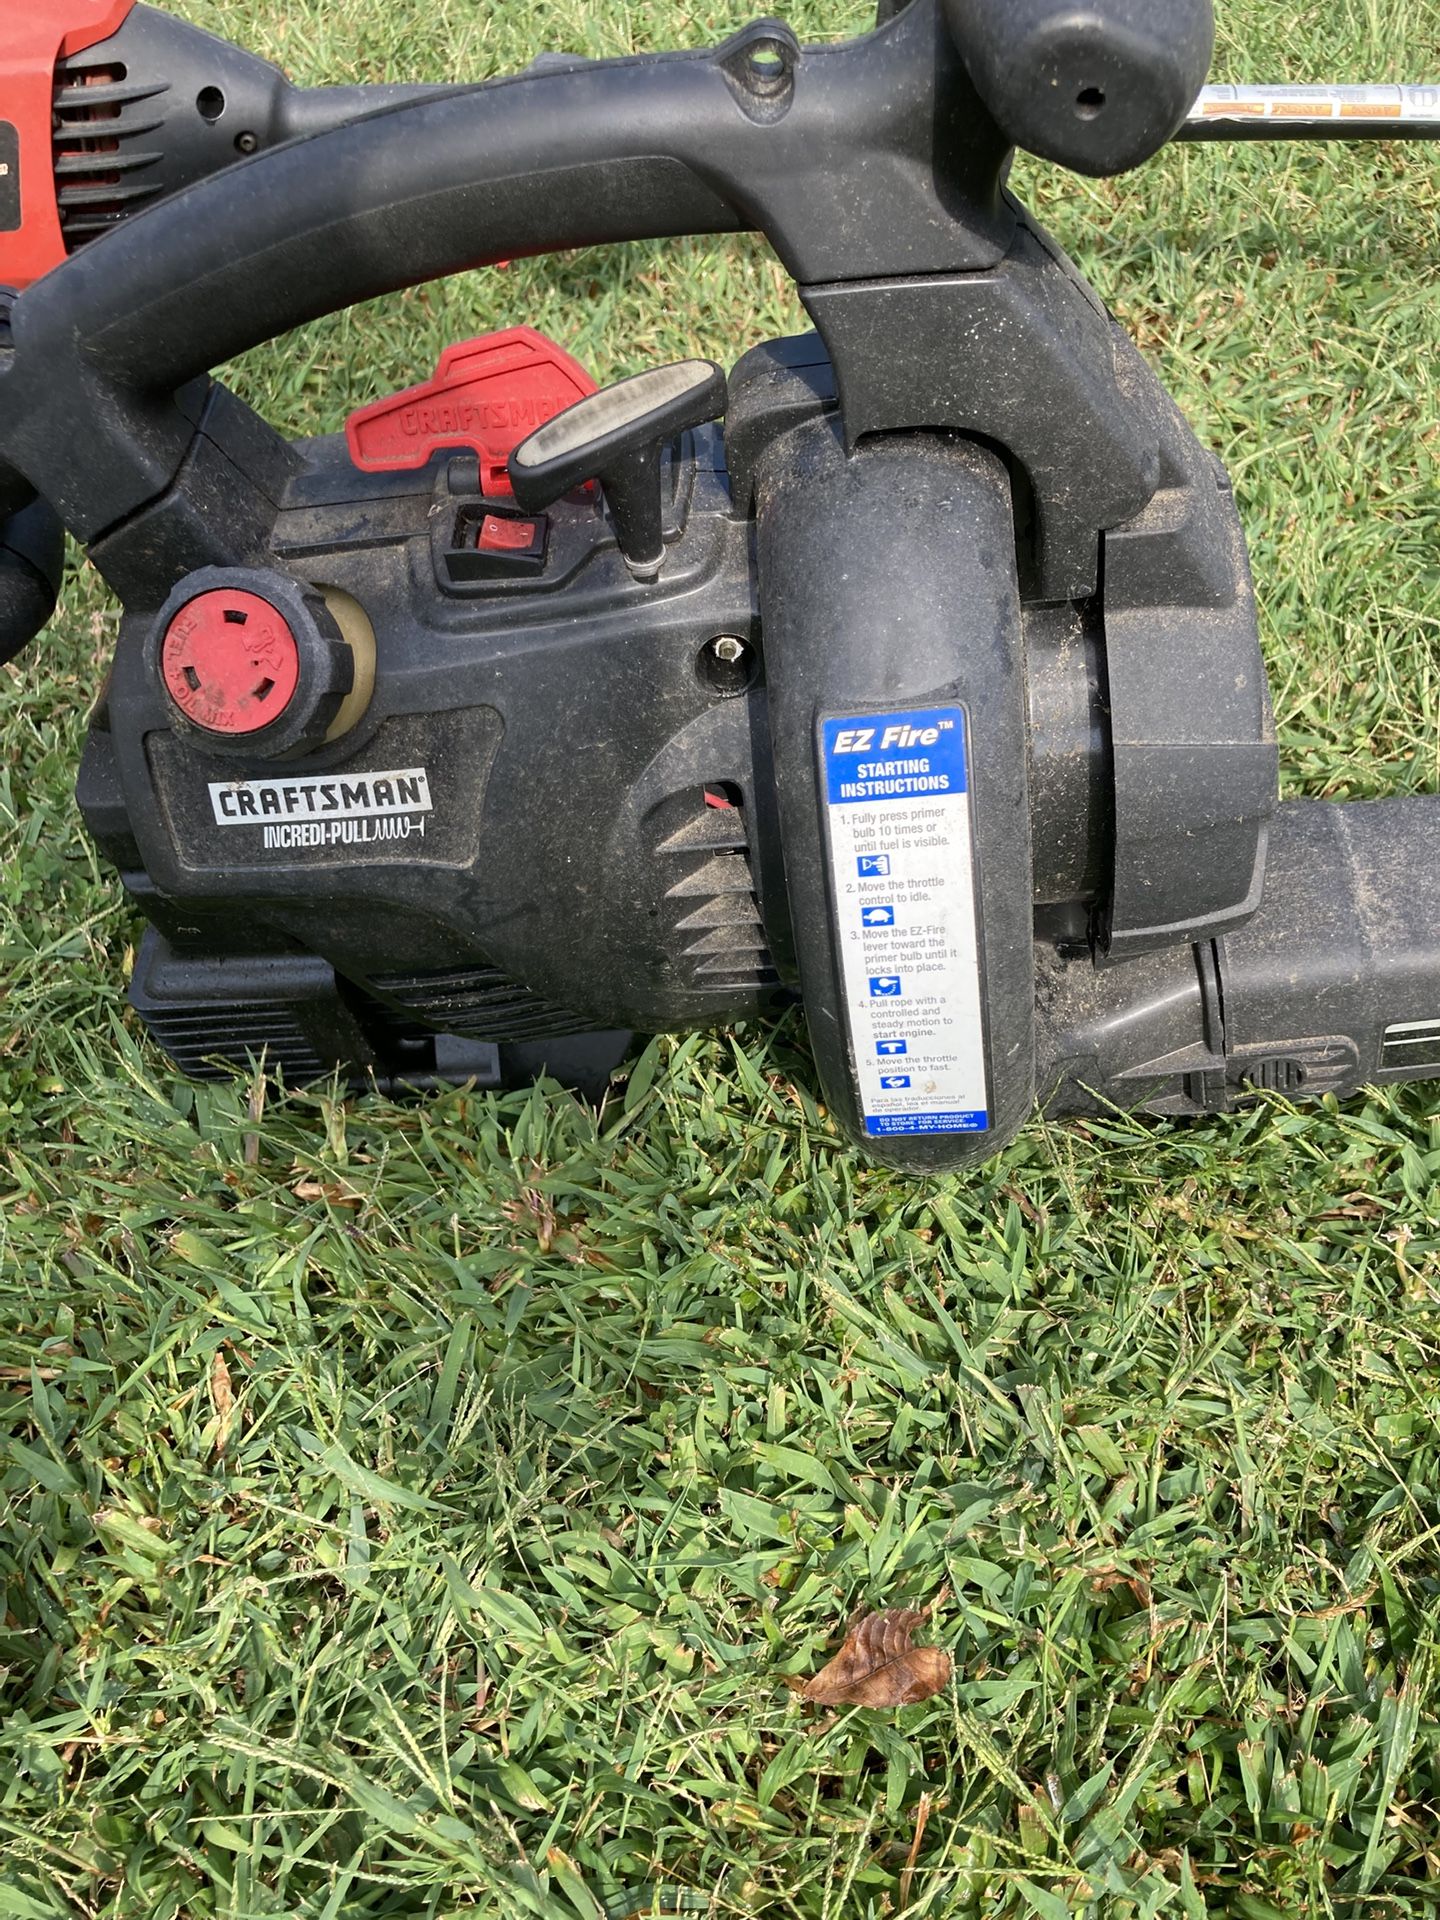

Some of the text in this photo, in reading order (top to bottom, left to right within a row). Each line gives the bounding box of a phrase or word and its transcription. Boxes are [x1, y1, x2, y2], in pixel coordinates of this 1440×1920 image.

[174, 687, 197, 713] OIL
[202, 708, 235, 727] MIX
[833, 729, 876, 754] EZ
[857, 758, 930, 779] STARTING
[840, 775, 950, 798] INSTRUCTIONS
[840, 807, 945, 826] 1. Fully press primer
[263, 820, 372, 849] INCREDI-PULL
[853, 824, 937, 838] bulb 10 times or
[854, 836, 950, 853] until fuel is visible.
[846, 877, 945, 894] 2. Move the throttle
[859, 892, 931, 906] control to idle.
[850, 926, 946, 940] 3. Move the EZ-Fire
[863, 938, 945, 952] lever toward the
[864, 949, 957, 965] primer bulb until it
[866, 963, 946, 975] locks into place.
[870, 999, 888, 1008] Pull
[890, 998, 912, 1008] rope
[915, 996, 937, 1005] with
[871, 1006, 941, 1018] controlled and
[872, 1017, 953, 1029] steady motion to
[873, 1029, 936, 1039] start engine.
[877, 1058, 903, 1066] Move
[905, 1056, 920, 1064] the
[922, 1054, 958, 1063] throttle
[877, 1065, 915, 1075] position
[930, 1063, 951, 1071] fast.
